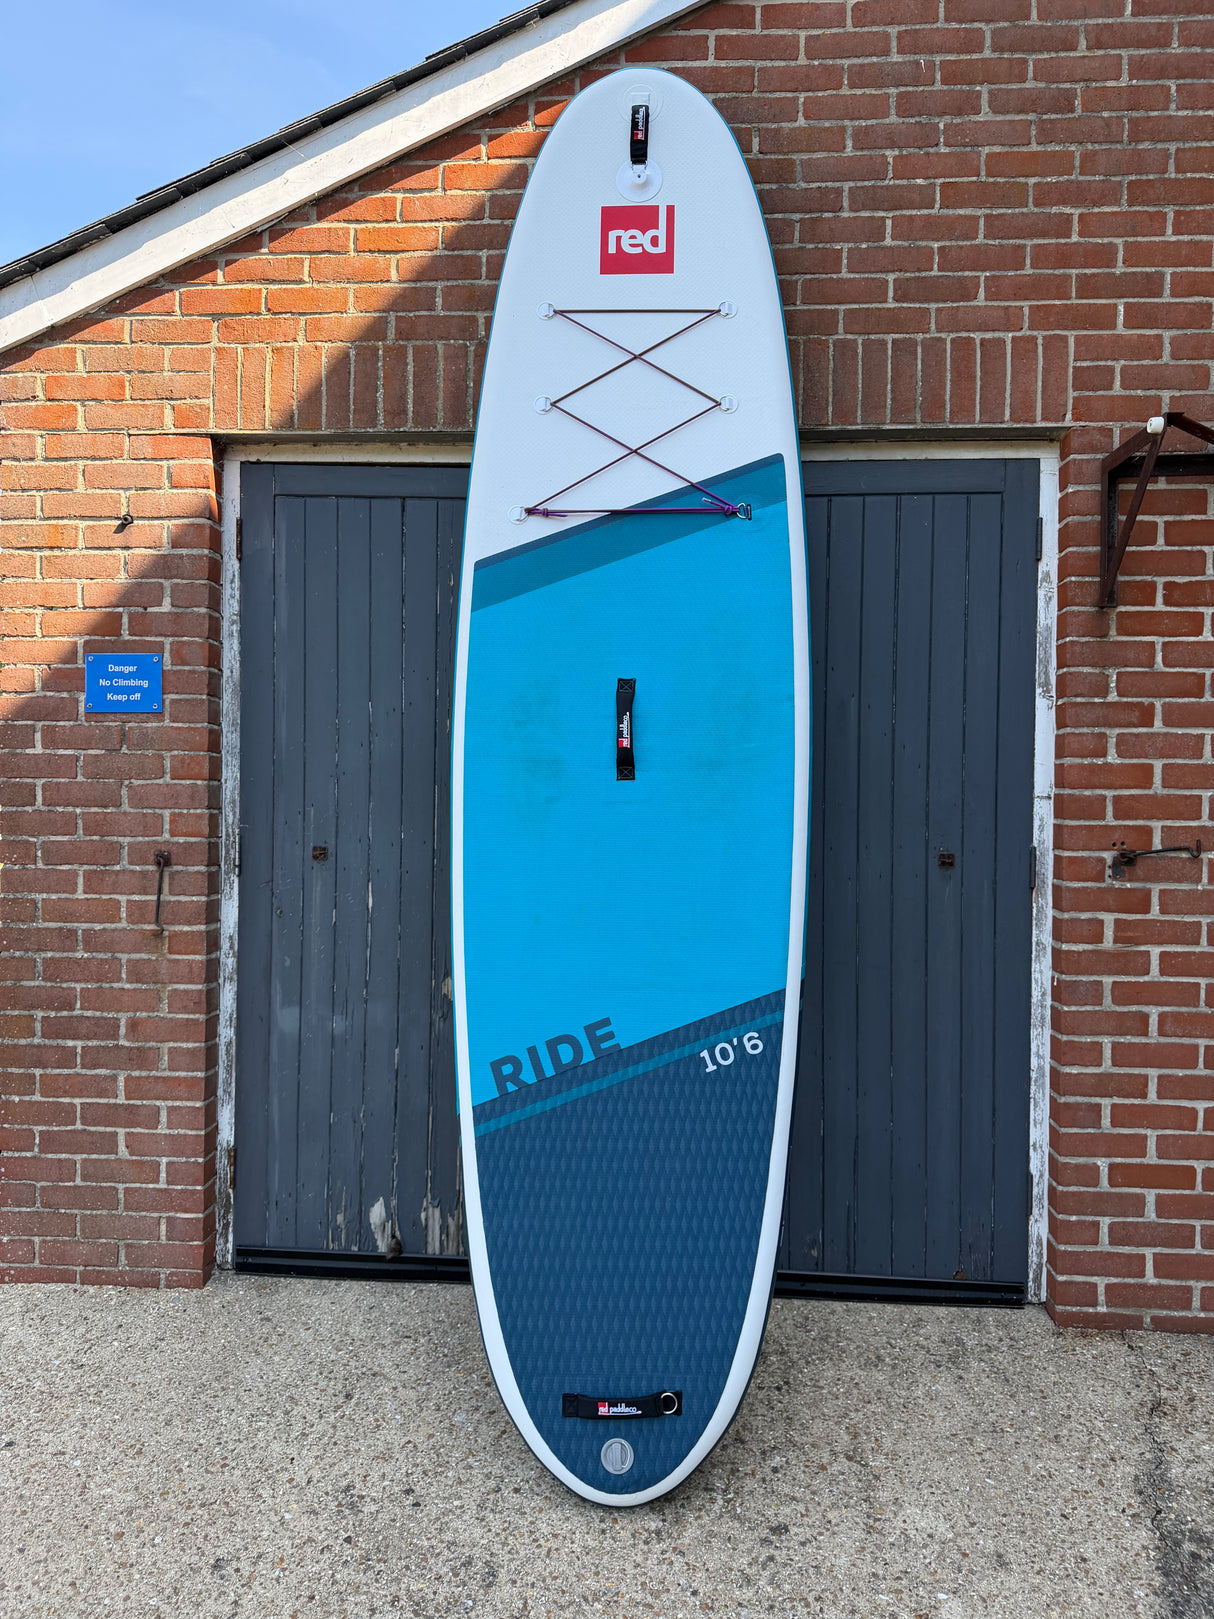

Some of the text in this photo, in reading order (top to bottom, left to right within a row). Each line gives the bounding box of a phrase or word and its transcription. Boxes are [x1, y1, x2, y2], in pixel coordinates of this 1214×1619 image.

[608, 205, 667, 254] red
[108, 664, 138, 674] Danger
[99, 678, 149, 688] No Climbing
[106, 692, 141, 702] Keep off
[489, 1016, 622, 1098] RIDE
[699, 1031, 764, 1073] 10'6
